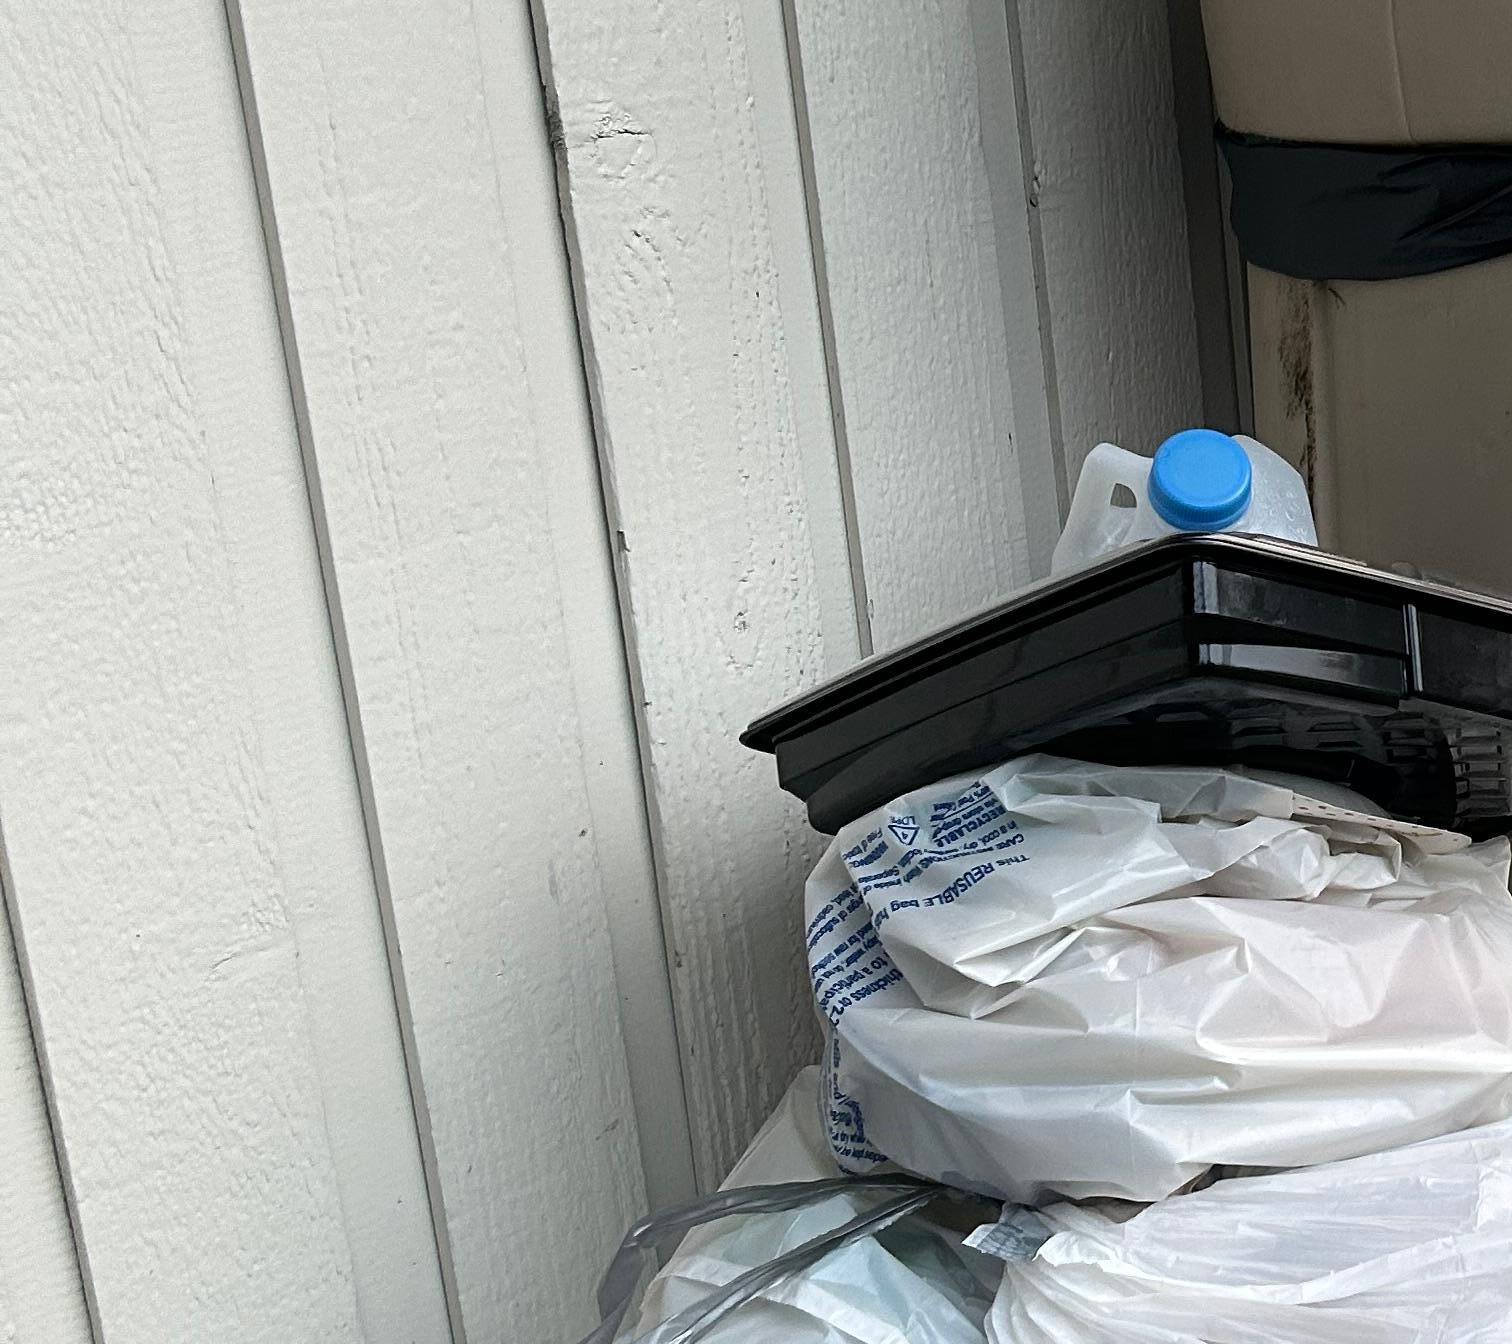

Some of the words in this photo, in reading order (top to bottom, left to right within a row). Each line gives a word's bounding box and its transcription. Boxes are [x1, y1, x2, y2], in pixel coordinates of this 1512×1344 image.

[995, 854, 1031, 867] This
[922, 862, 995, 908] REUSABLE
[889, 899, 920, 912] bag
[870, 955, 888, 971] to
[861, 966, 874, 975] a
[850, 968, 904, 1002] thickness
